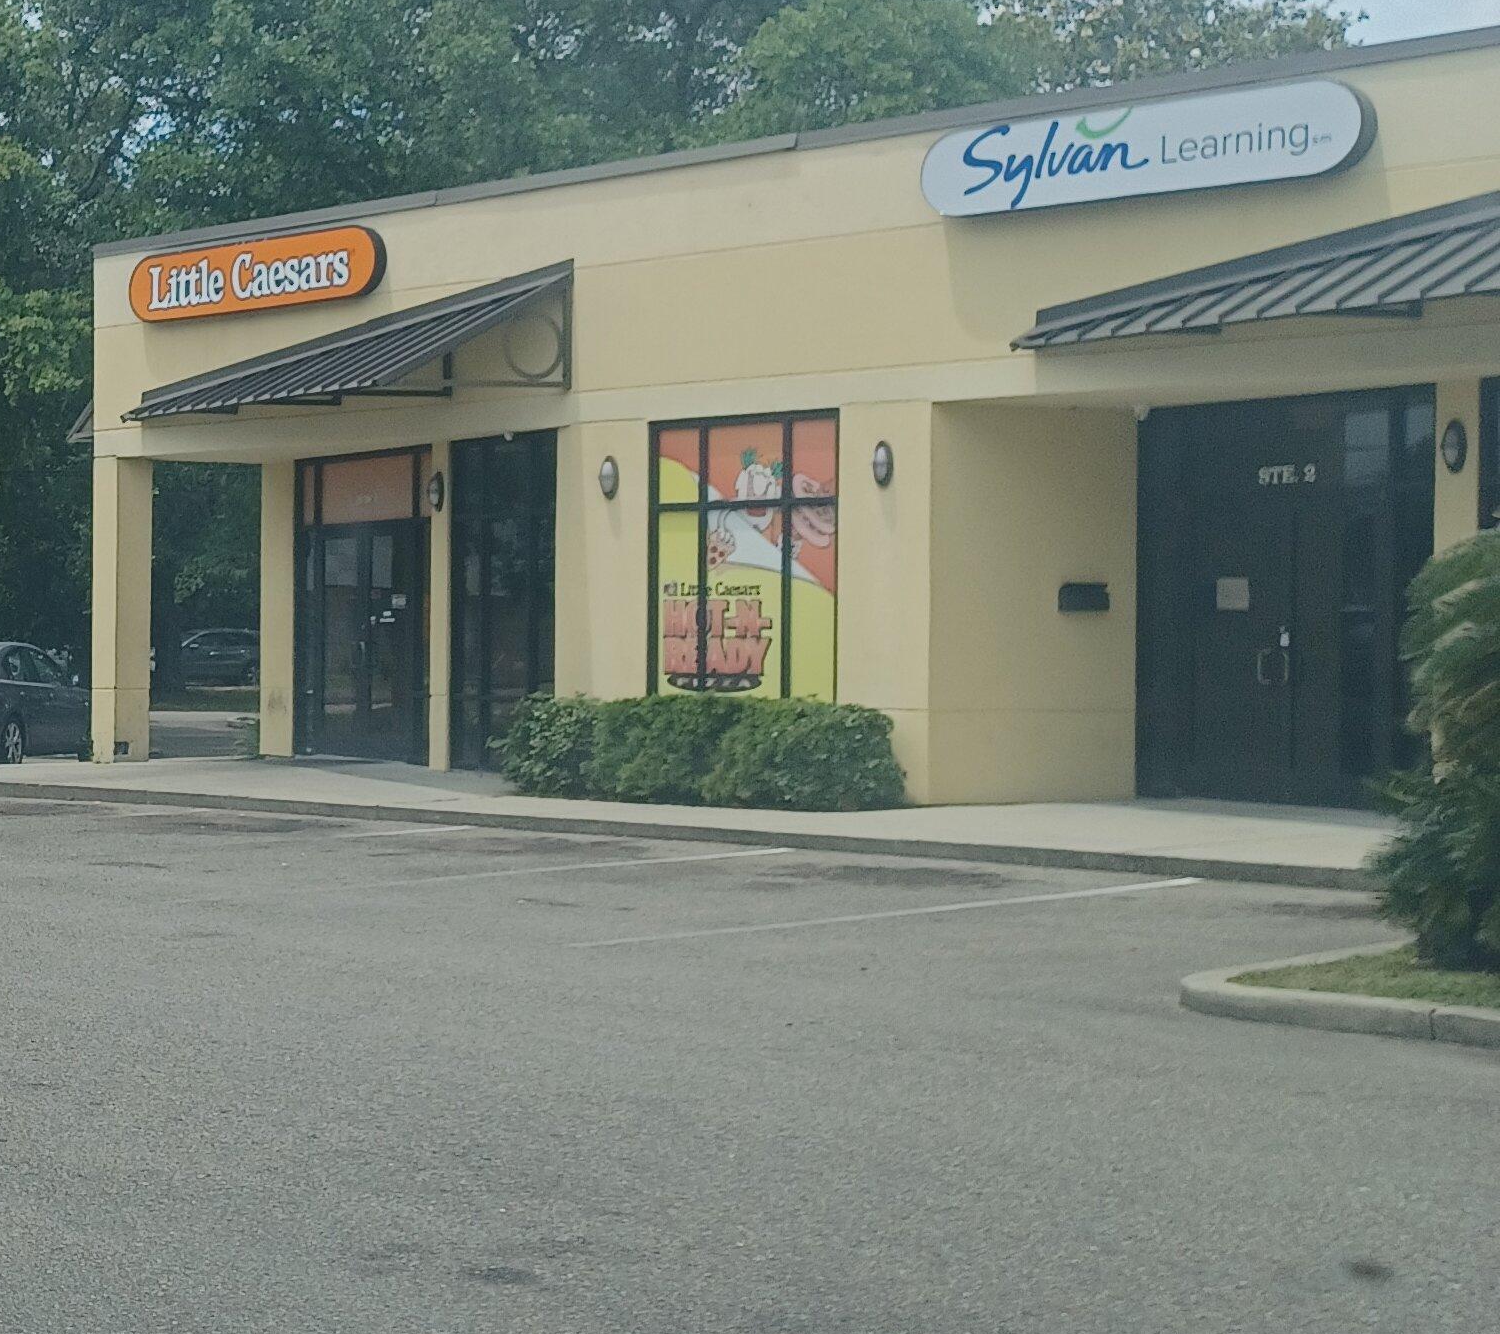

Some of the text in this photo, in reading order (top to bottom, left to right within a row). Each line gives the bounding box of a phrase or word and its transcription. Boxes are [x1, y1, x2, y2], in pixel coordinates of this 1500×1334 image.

[962, 120, 1149, 209] Sylvan
[1161, 119, 1310, 165] Learning
[148, 249, 350, 311] Little Caesars
[680, 582, 713, 596] Lite
